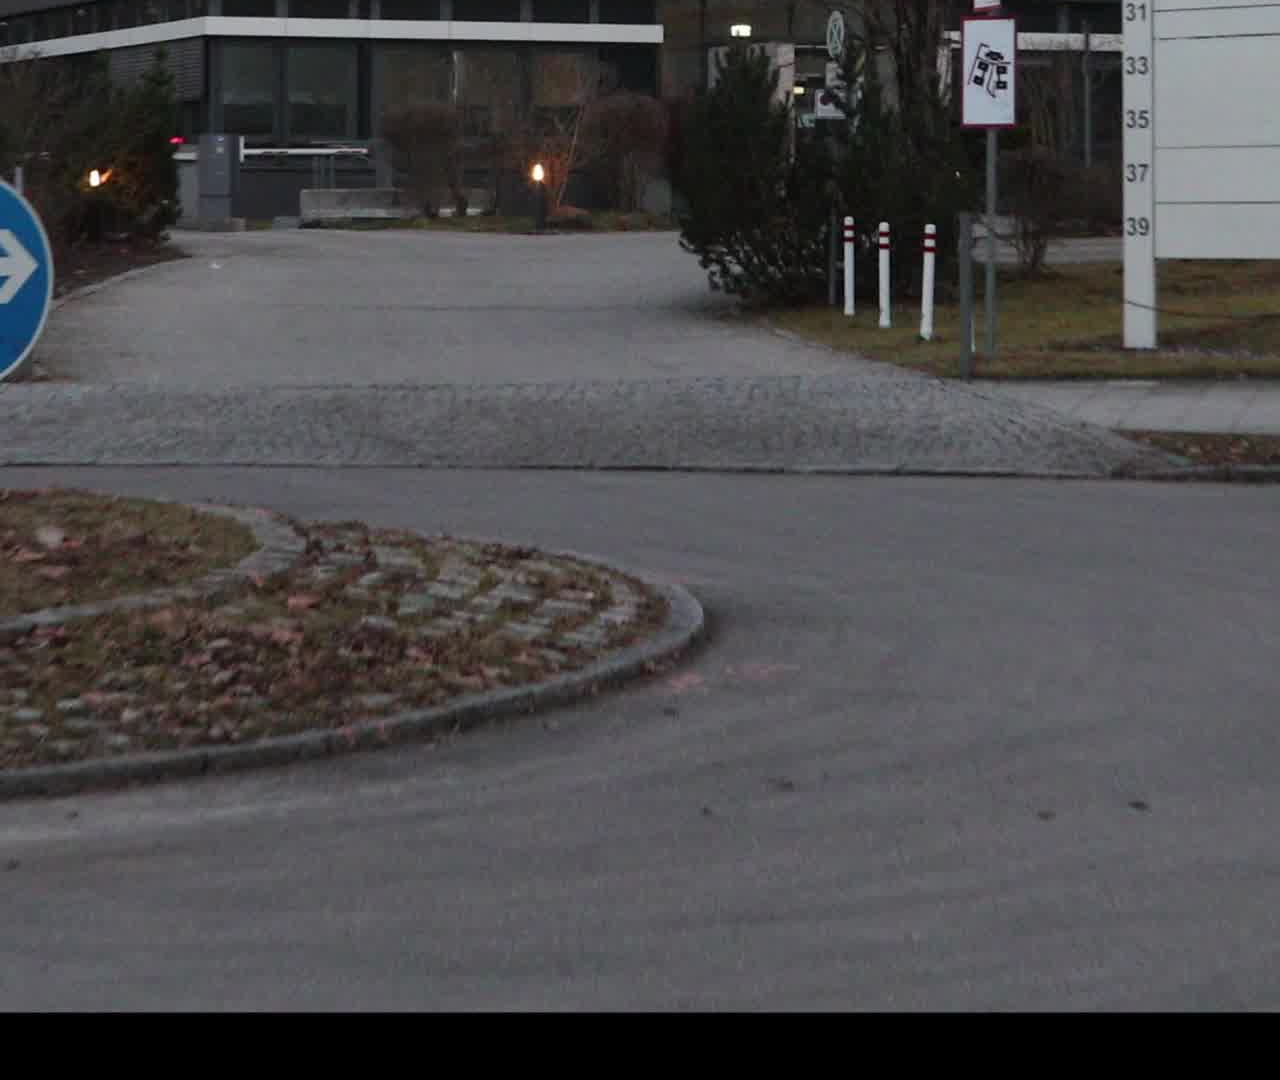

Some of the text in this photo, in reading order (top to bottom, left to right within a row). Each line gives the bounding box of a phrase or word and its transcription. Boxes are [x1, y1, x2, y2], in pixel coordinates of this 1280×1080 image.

[1125, 3, 1147, 22] 31
[1125, 56, 1149, 75] 33
[1125, 110, 1150, 129] 35
[1126, 164, 1149, 183] 37
[1126, 217, 1150, 237] 39
